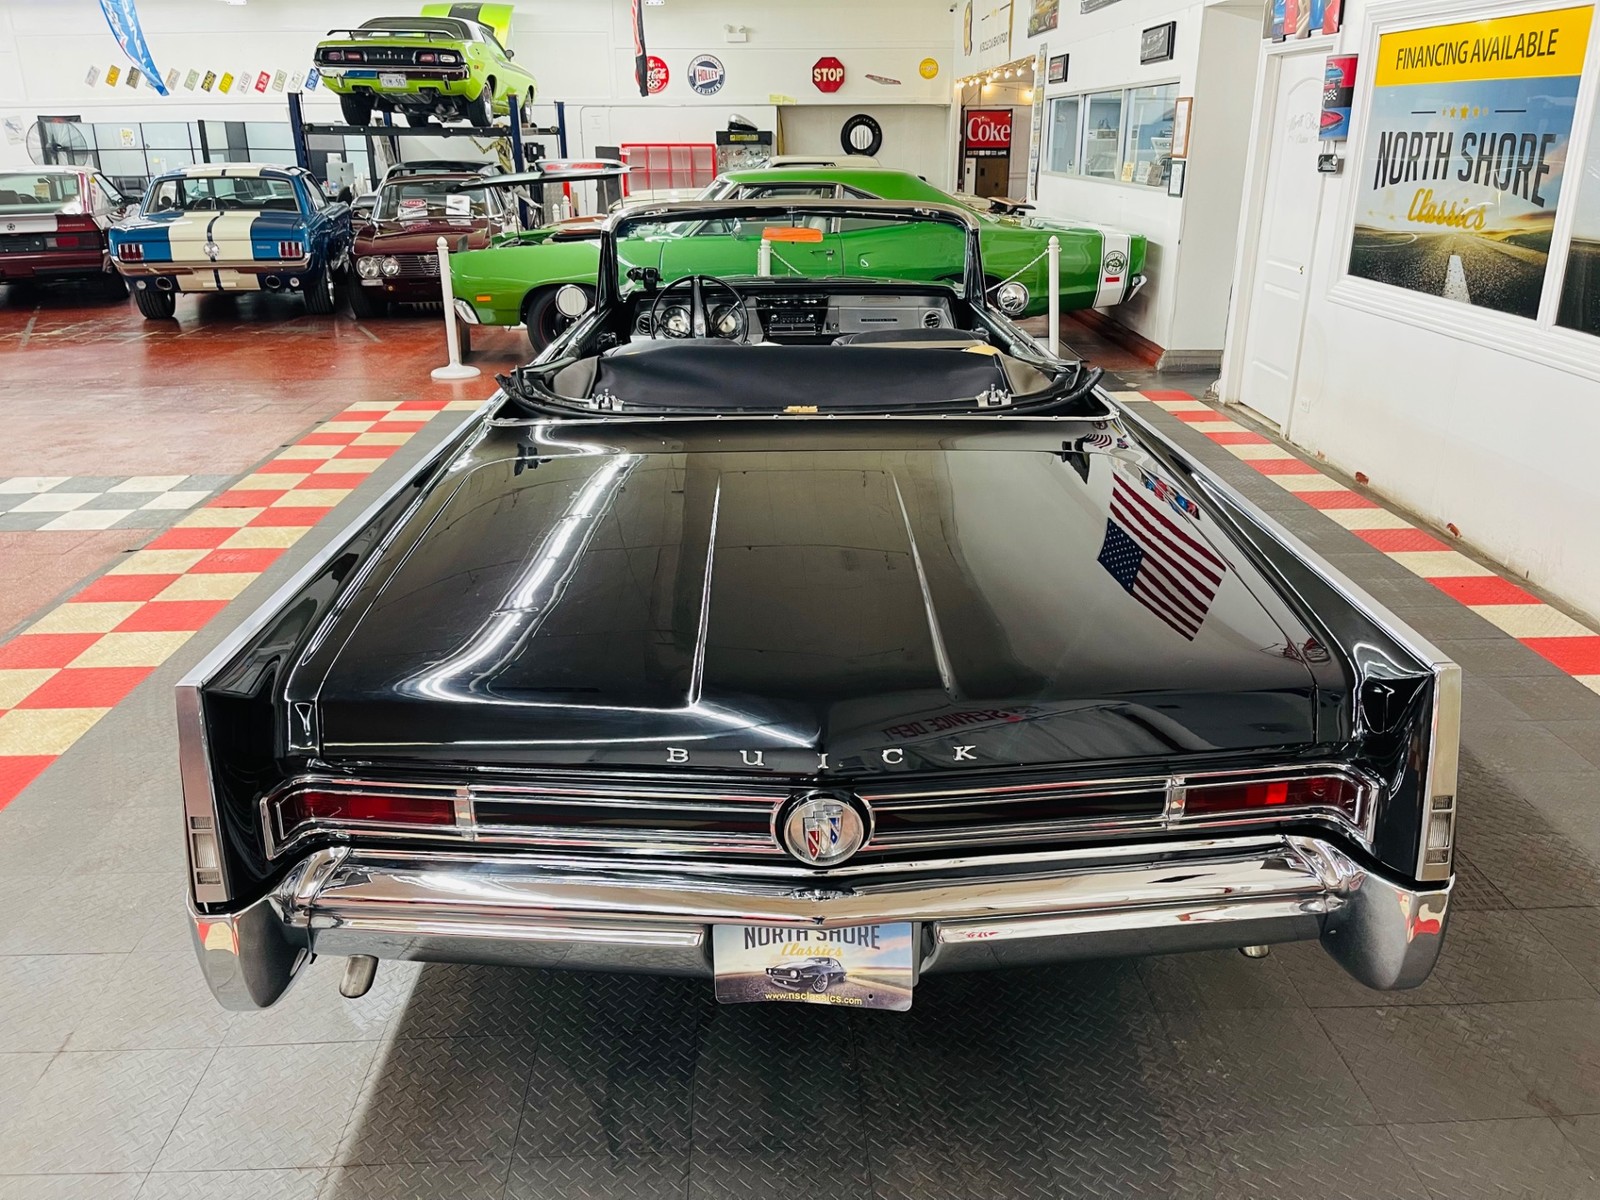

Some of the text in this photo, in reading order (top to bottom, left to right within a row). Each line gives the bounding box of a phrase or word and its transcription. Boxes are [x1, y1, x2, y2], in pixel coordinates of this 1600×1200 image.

[1395, 28, 1559, 71] FINANCING AVAILABLE
[697, 68, 718, 83] HOLLEY
[813, 68, 844, 82] STOP
[967, 116, 1011, 142] Coke
[1373, 131, 1557, 209] NORTH SHORE
[1407, 187, 1488, 231] Classics
[666, 745, 978, 770] BUICK
[744, 925, 881, 950] NORTH SHORE
[781, 943, 844, 957] Classics
[764, 991, 863, 1006] www.nsclassics.com
